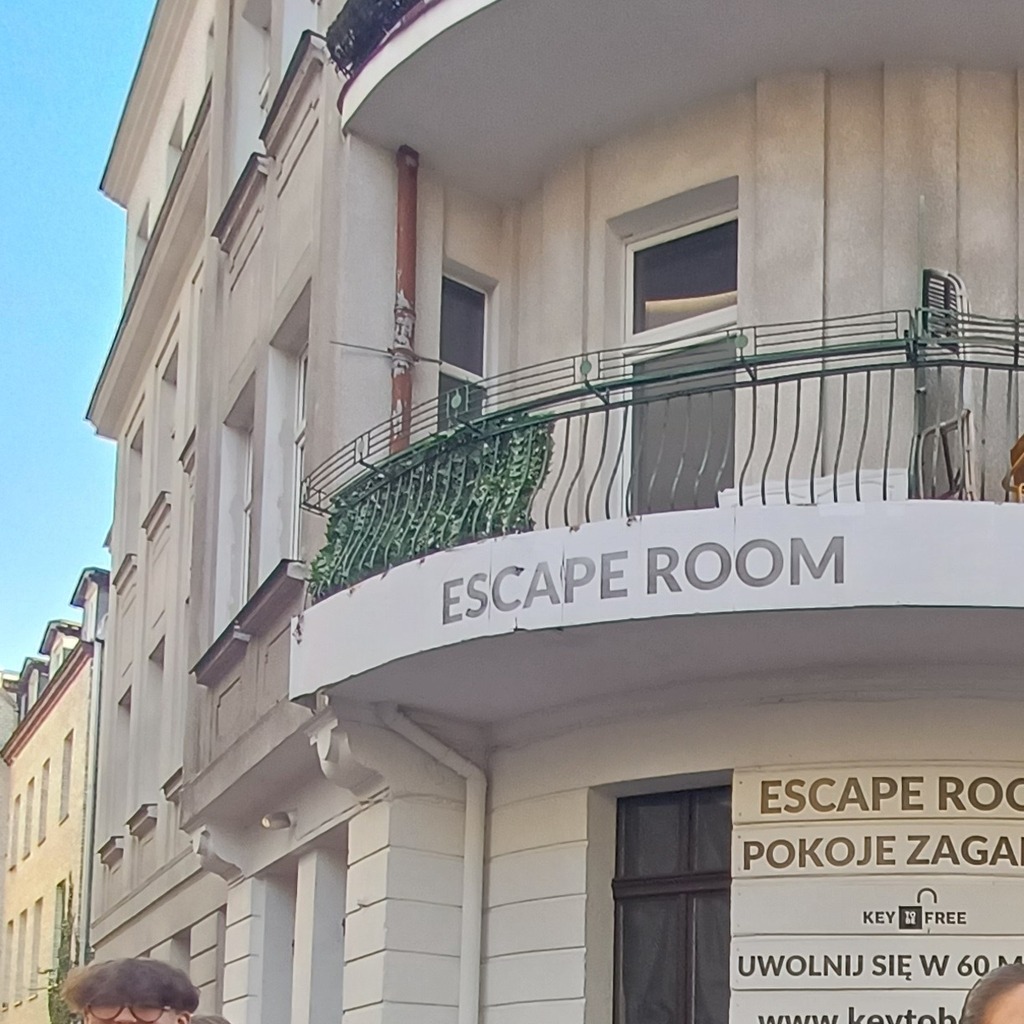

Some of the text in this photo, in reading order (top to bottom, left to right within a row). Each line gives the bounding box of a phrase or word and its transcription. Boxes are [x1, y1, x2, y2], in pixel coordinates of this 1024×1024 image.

[442, 536, 845, 625] ESCAPE ROOM
[760, 776, 924, 815] ESCAPE
[743, 836, 896, 871] POKOJE
[863, 911, 896, 924] KEY
[925, 911, 967, 925] FREE
[738, 955, 864, 977] UWOLNIJ
[872, 955, 912, 981] SIĘ
[919, 955, 950, 976] W
[957, 955, 990, 977] 60
